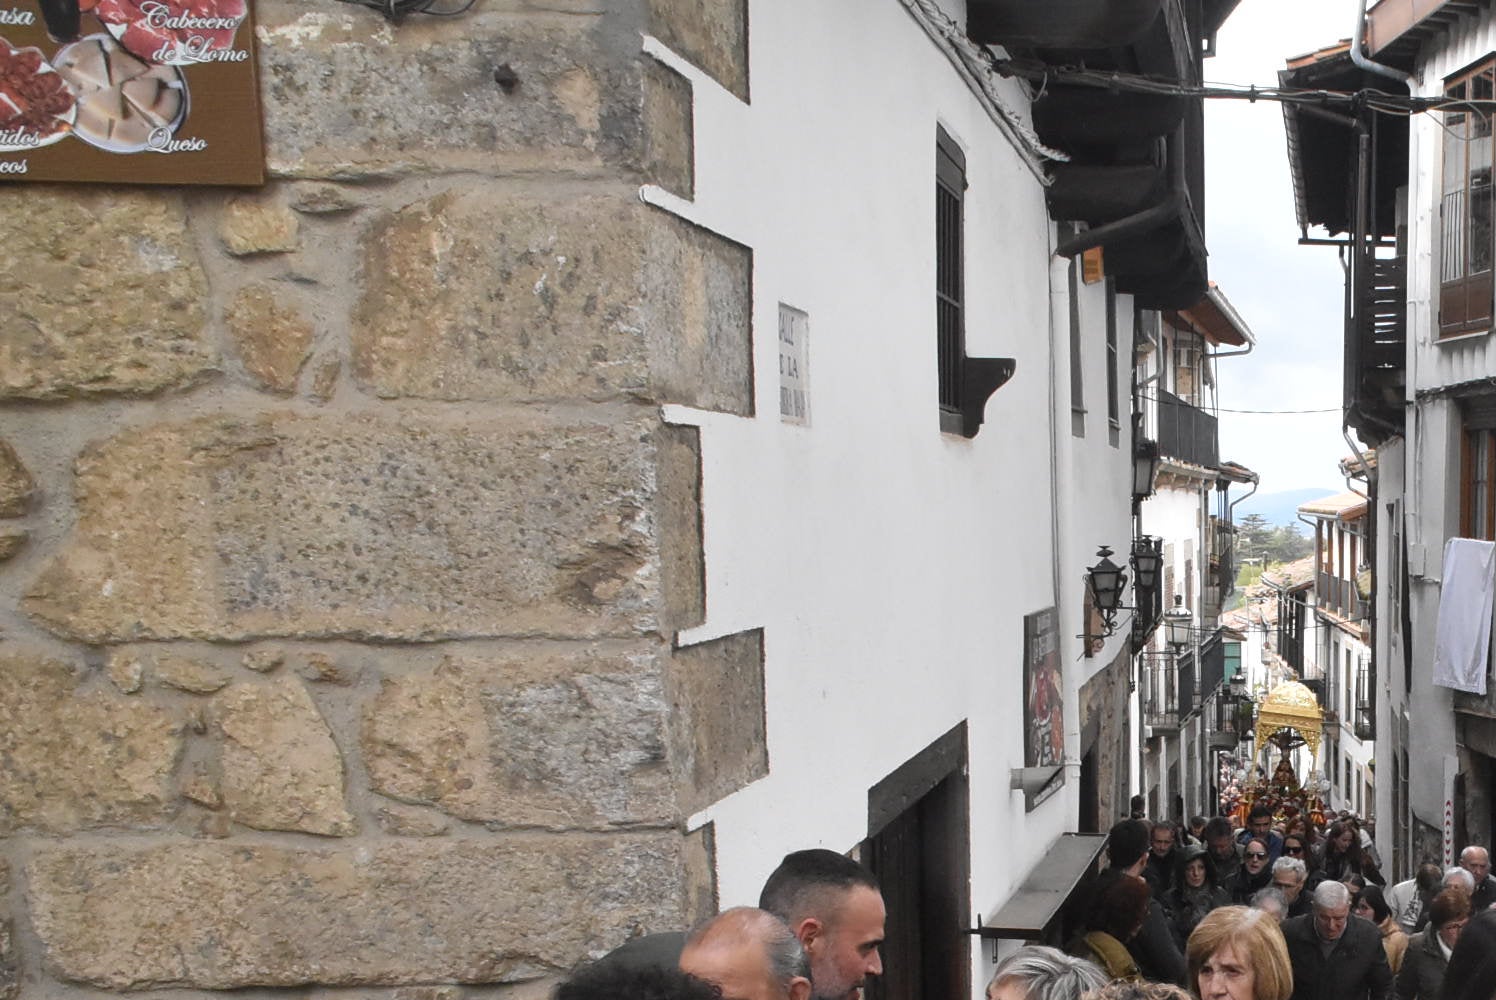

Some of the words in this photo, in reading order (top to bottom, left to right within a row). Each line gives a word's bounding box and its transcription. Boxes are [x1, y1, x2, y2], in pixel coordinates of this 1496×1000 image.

[140, 1, 236, 29] Cabecero
[152, 41, 176, 60] de
[184, 35, 249, 62] Lomo
[0, 125, 39, 146] idos
[145, 127, 208, 154] Queso
